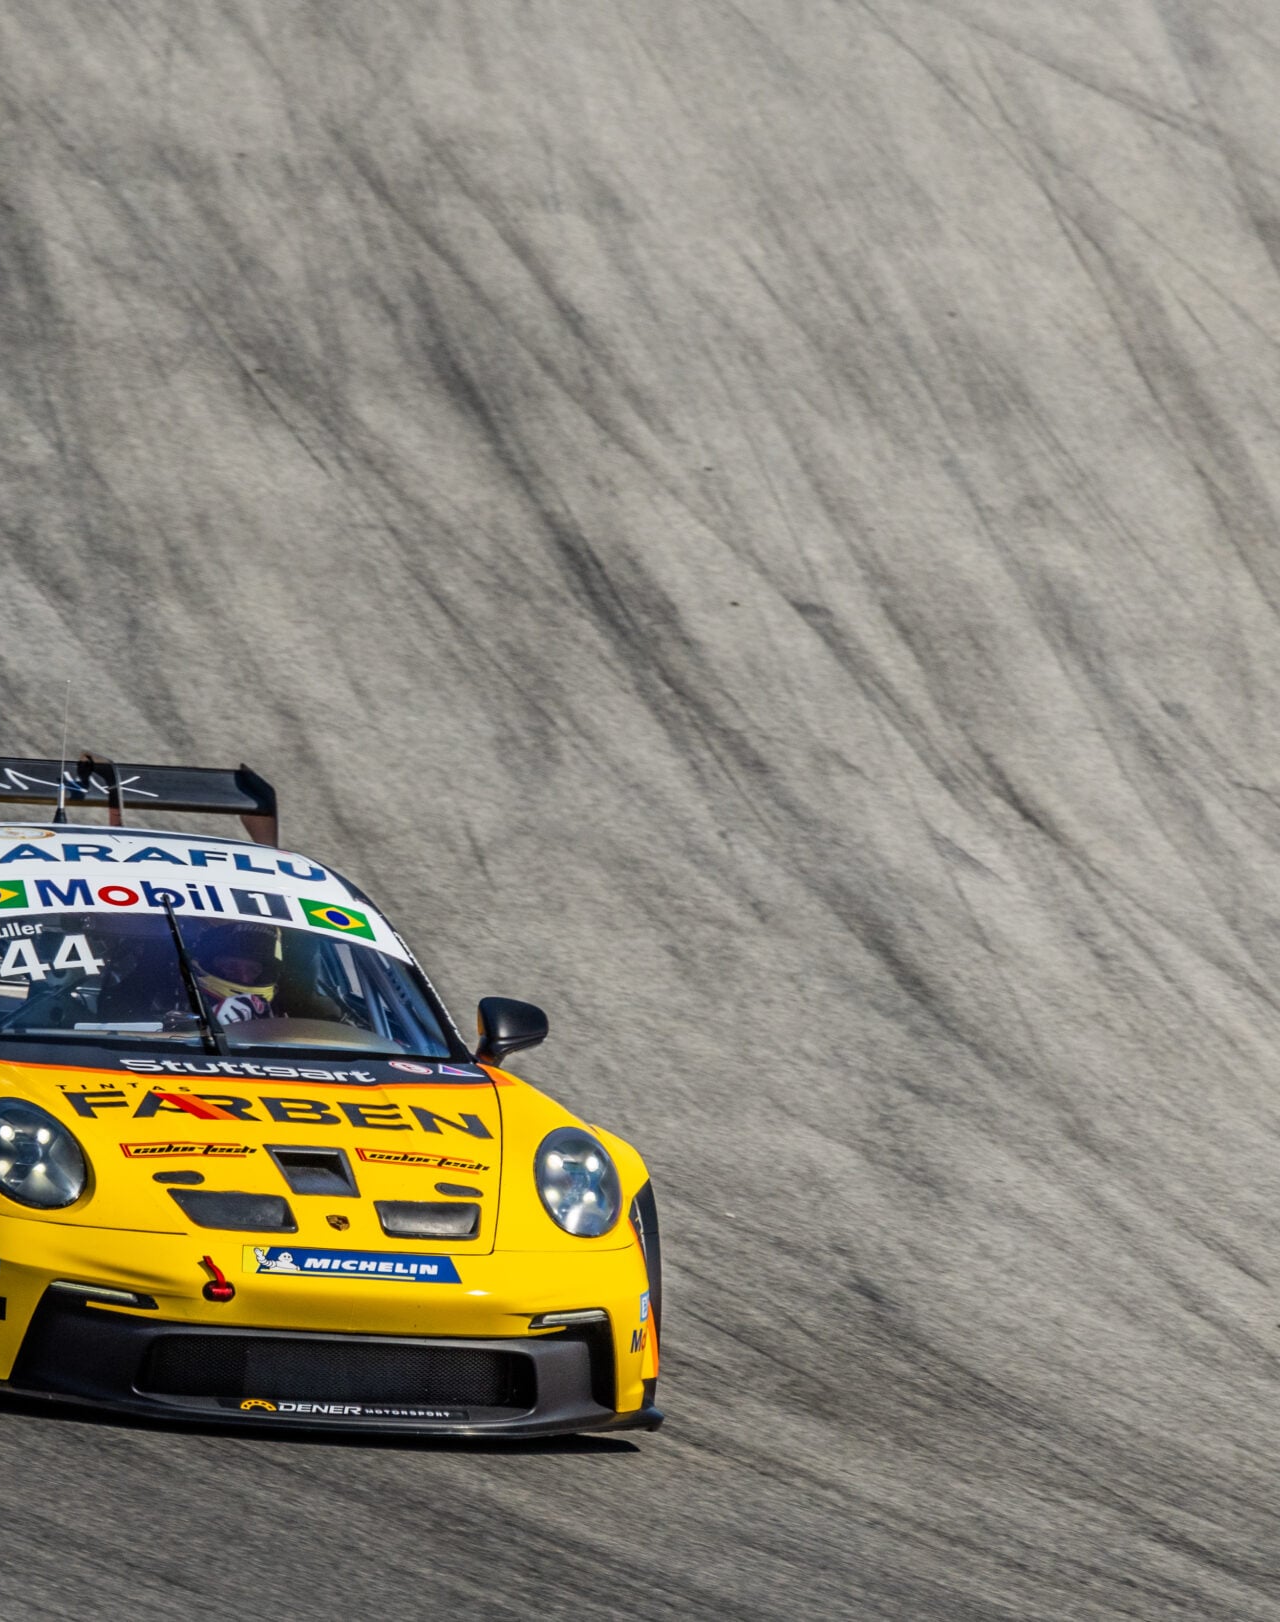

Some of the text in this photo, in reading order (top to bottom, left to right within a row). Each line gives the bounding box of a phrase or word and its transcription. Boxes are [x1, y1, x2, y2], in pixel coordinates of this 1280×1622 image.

[34, 879, 222, 913] Mobil
[120, 1059, 377, 1084] Stuttgart
[55, 1082, 192, 1093] TINTAS
[61, 1090, 495, 1139] FARBEN
[303, 1256, 439, 1276] MICHELIN
[278, 1401, 451, 1418] DENER MOTORSPORT
